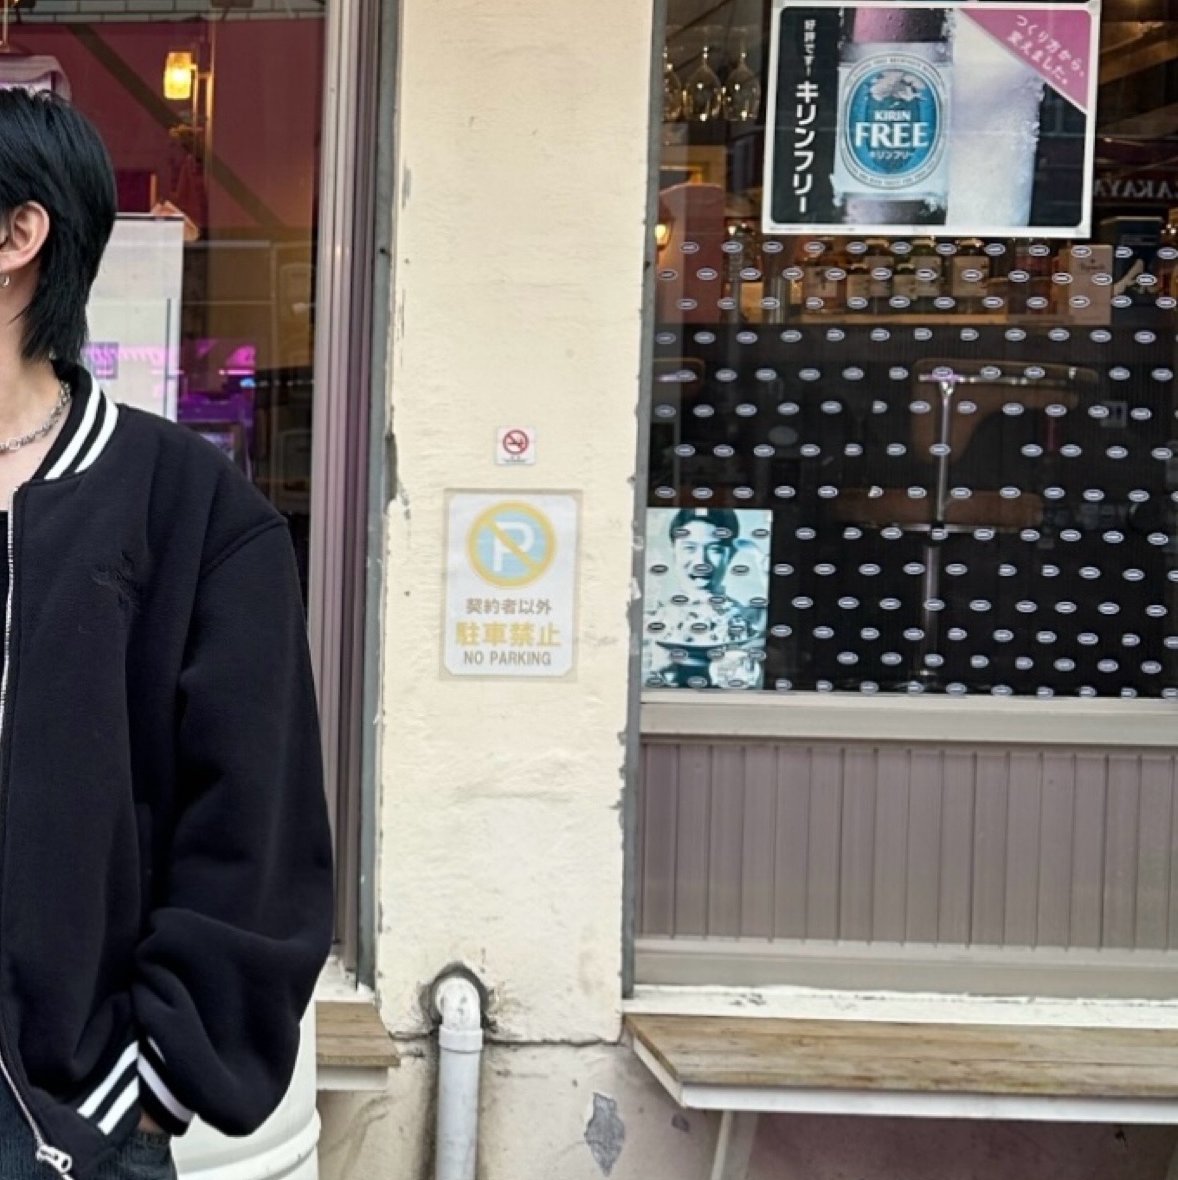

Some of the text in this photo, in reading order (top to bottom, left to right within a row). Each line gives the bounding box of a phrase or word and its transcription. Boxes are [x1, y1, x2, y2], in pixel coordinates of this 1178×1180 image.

[874, 110, 911, 121] KIRIN
[855, 121, 929, 149] FREE
[792, 80, 819, 213] キリンフリー
[466, 598, 552, 615] 契約者以外
[455, 620, 562, 647] 駐車禁止
[464, 650, 552, 666] NO PARKING
